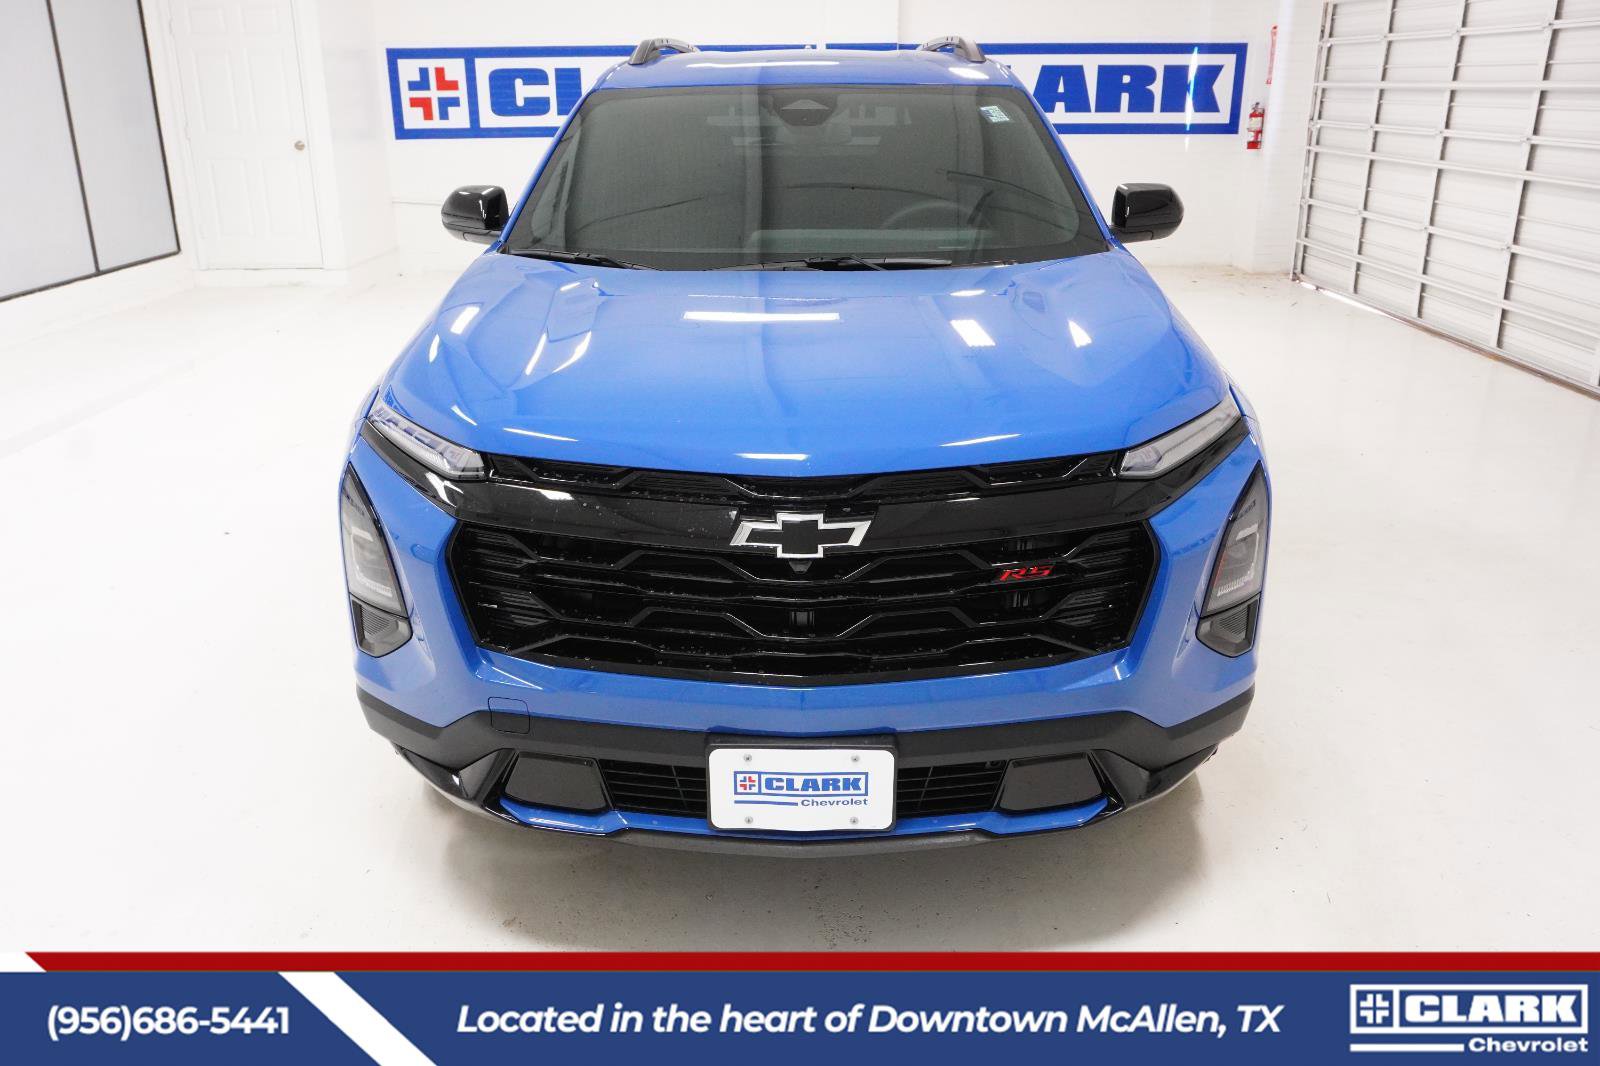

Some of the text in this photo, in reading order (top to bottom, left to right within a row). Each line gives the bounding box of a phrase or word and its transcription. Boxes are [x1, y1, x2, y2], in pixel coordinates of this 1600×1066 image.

[1032, 64, 1225, 114] ARK
[1000, 566, 1055, 581] RS
[764, 777, 862, 792] CLARK
[800, 798, 869, 807] Chevrolet
